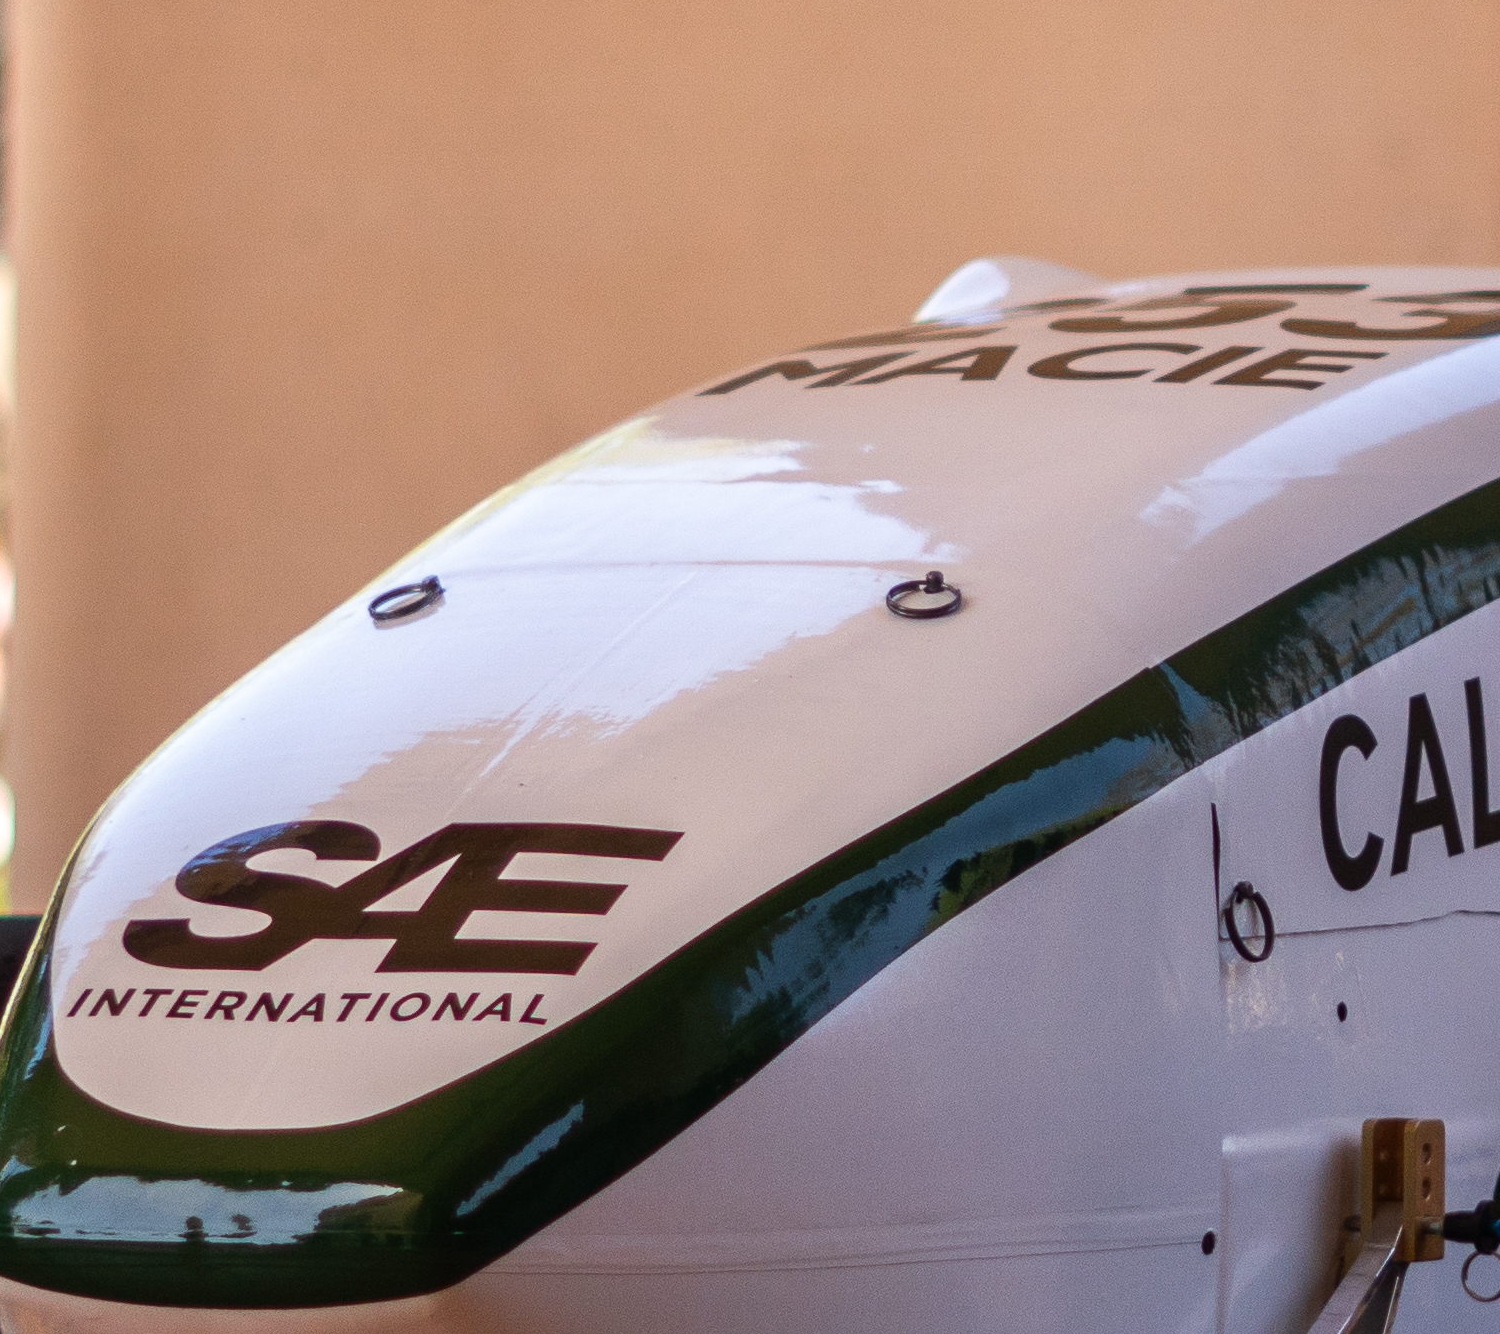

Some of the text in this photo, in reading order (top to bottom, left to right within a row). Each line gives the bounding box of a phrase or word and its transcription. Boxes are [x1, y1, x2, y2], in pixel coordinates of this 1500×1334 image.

[694, 342, 1388, 397] MACIE
[121, 819, 685, 976] SAE
[66, 988, 551, 1026] INTERNATIONAL
